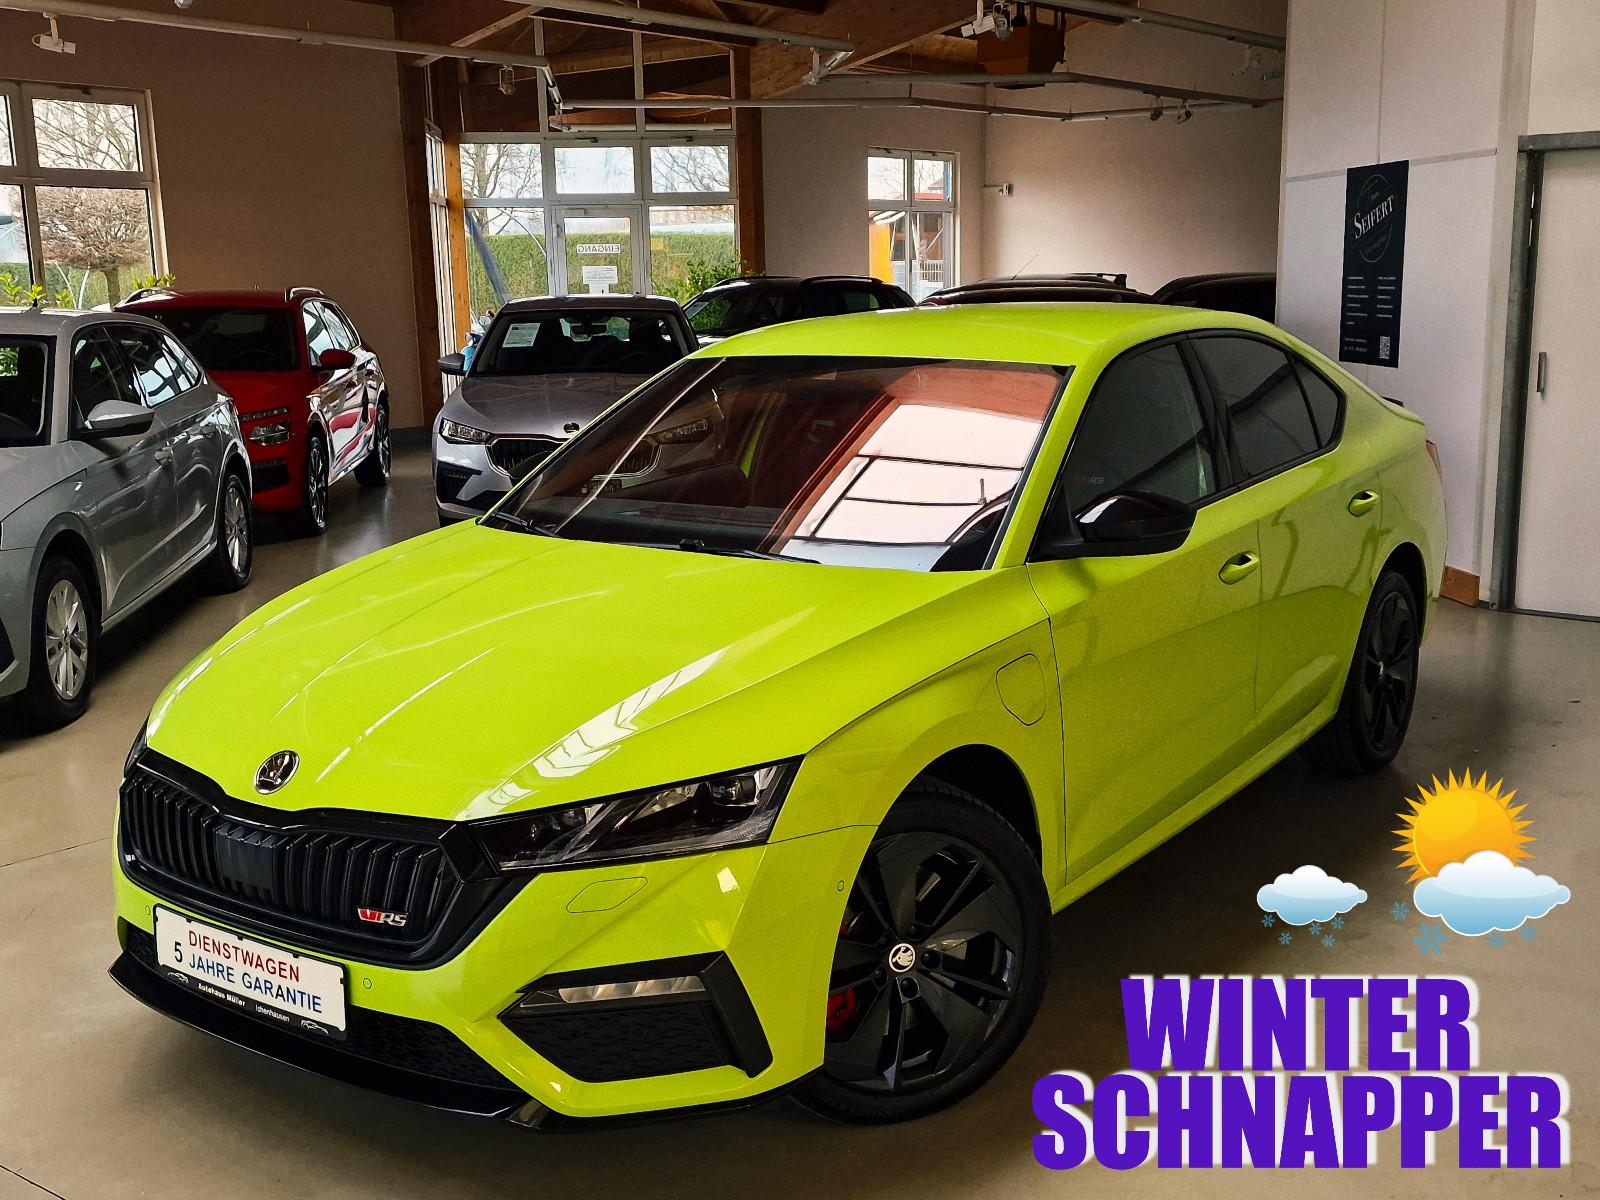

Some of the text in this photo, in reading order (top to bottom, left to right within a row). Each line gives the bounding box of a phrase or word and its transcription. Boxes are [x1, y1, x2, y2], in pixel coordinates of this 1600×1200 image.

[1354, 195, 1394, 239] SEIFERT
[174, 941, 322, 1013] 5 JAHRE GARANTIE
[188, 930, 300, 982] DIENSTWAGEN
[198, 983, 225, 999] Autohaus
[226, 993, 245, 1007] Müller
